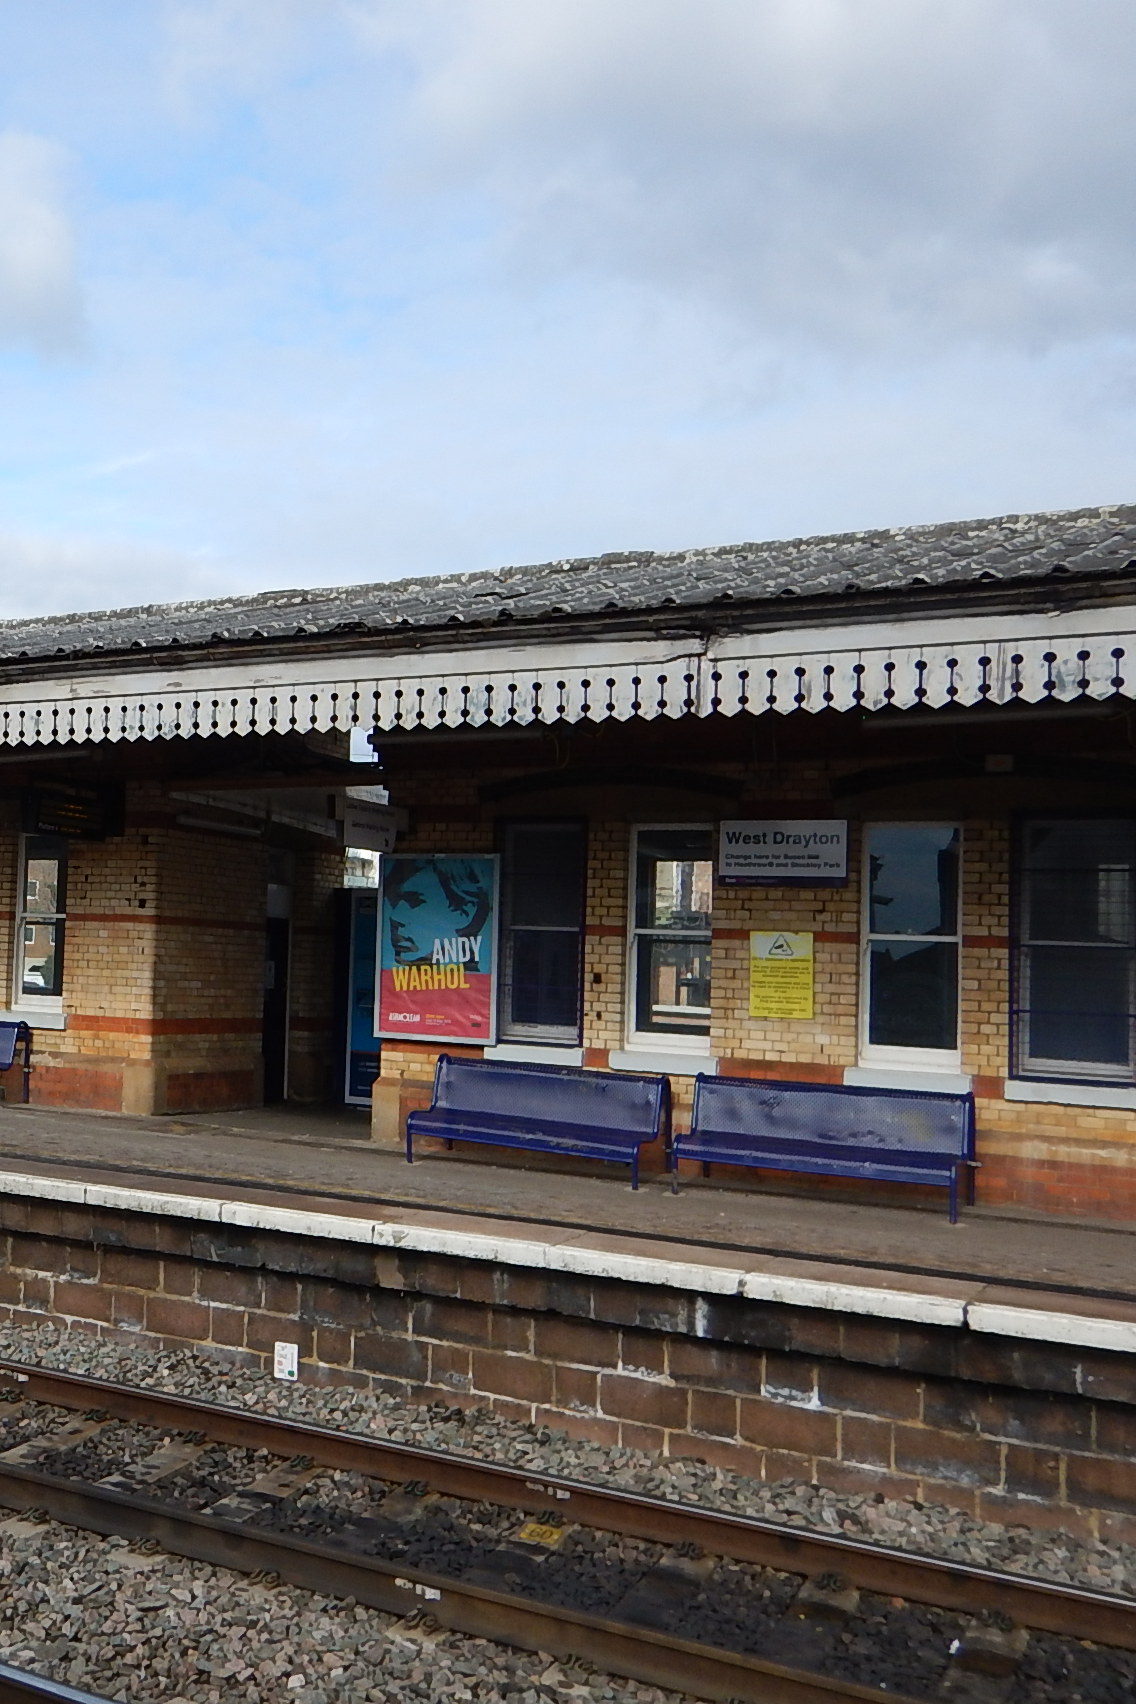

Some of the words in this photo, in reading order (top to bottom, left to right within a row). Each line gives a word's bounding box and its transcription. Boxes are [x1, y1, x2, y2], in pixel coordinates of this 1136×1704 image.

[726, 831, 768, 845] West
[773, 831, 840, 848] Drayton
[432, 936, 482, 964] ANDY
[392, 963, 470, 991] WARHOL
